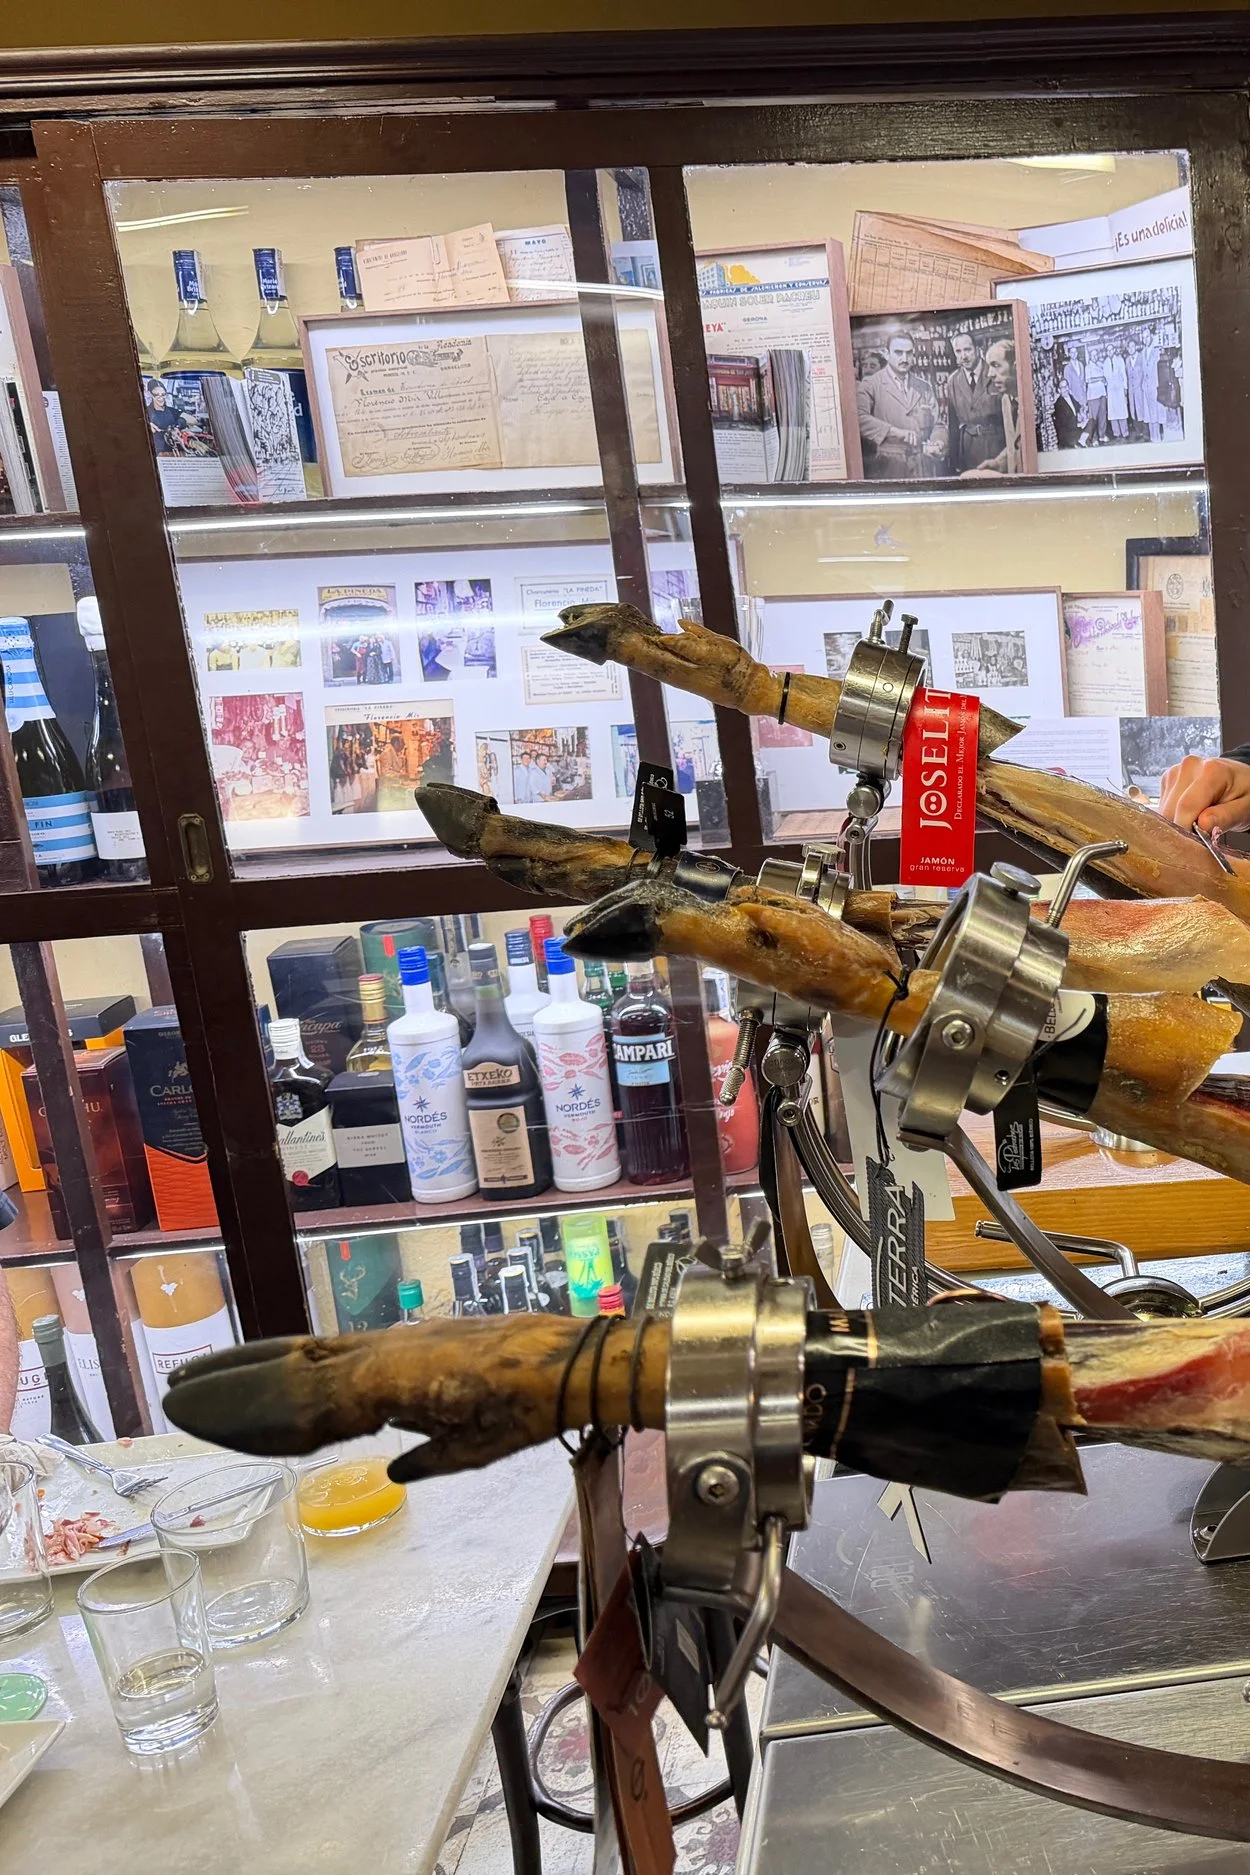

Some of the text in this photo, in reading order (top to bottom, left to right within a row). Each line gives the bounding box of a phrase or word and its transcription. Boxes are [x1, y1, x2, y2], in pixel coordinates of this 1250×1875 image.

[919, 688, 953, 831] JOSELIT
[34, 819, 53, 829] FIN
[920, 856, 955, 866] JAMÓN
[909, 864, 966, 873] gran reserva
[467, 1068, 513, 1082] ETXEKO
[149, 1084, 193, 1097] CARL
[555, 1097, 602, 1113] NORDÉS
[404, 1110, 448, 1123] NORDÉS
[78, 1357, 100, 1370] ELIS
